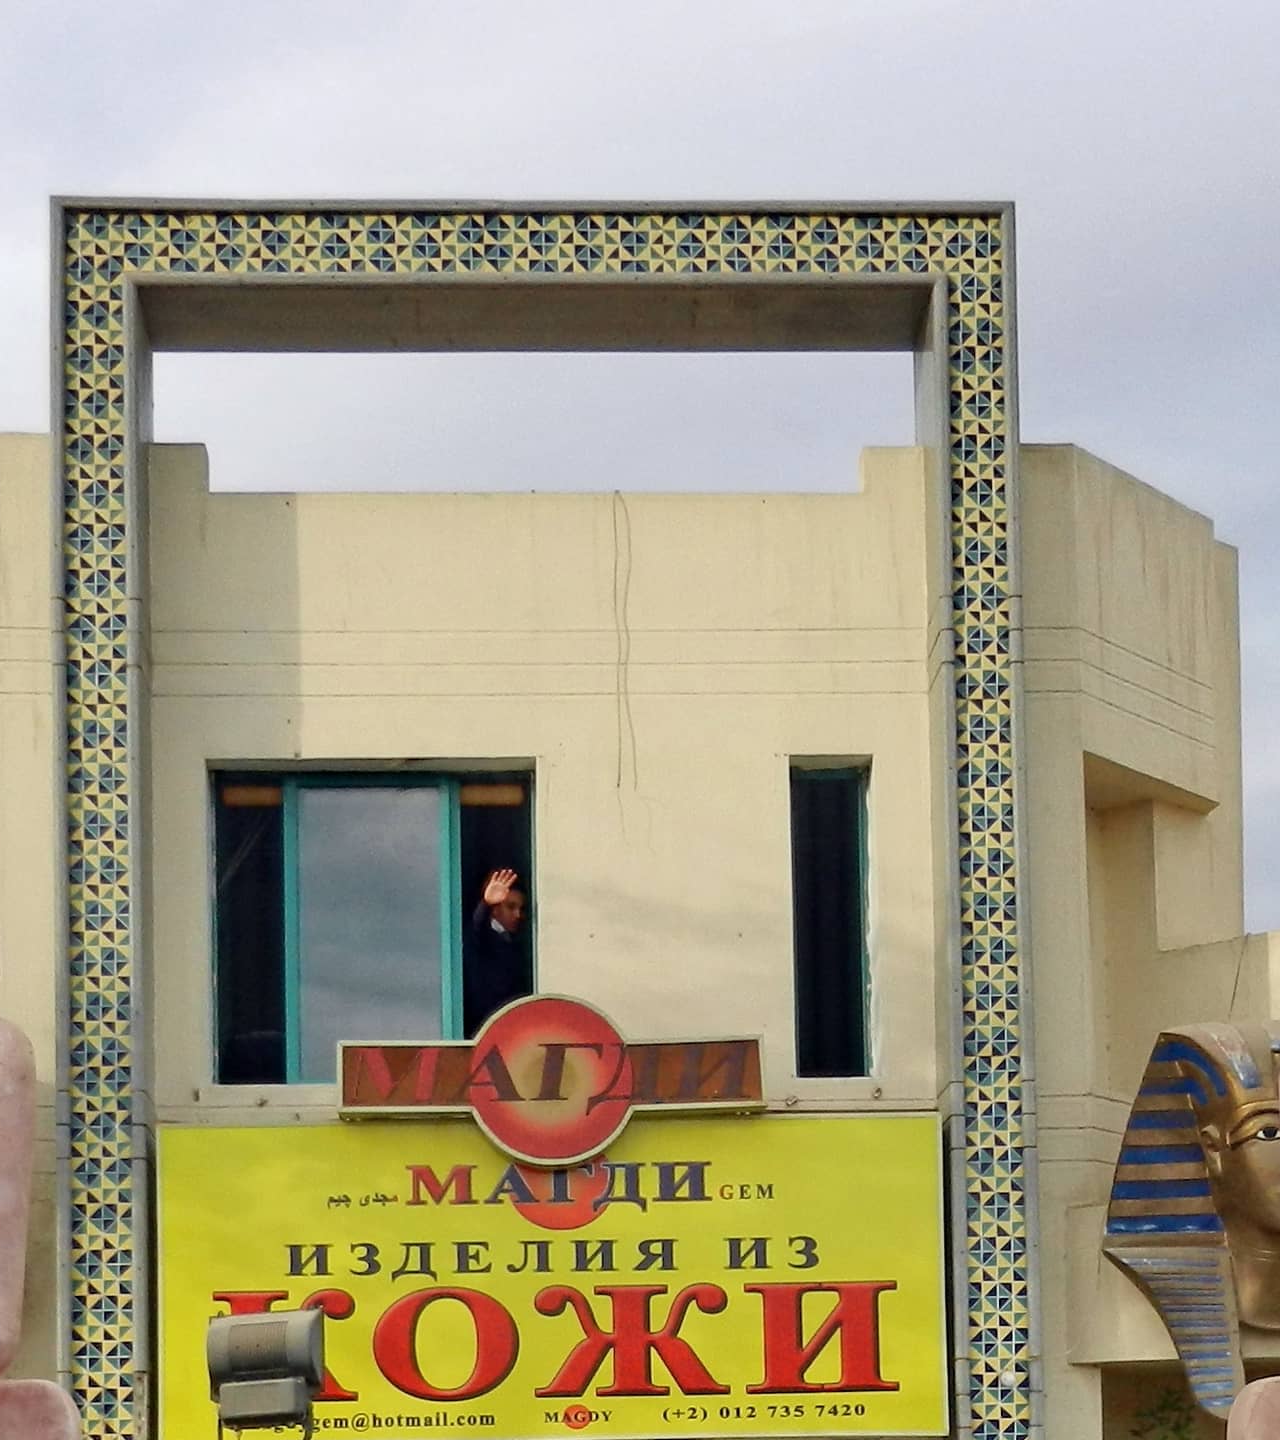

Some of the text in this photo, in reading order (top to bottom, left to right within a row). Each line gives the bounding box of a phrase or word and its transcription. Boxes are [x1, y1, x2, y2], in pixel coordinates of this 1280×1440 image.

[405, 1160, 775, 1213] МАГДИ GEM
[284, 1235, 821, 1283] ИЗДЕЛИЯ ИЗ
[544, 1410, 613, 1424] MAGDY
[661, 1403, 866, 1422] (+2) 012 735 7420
